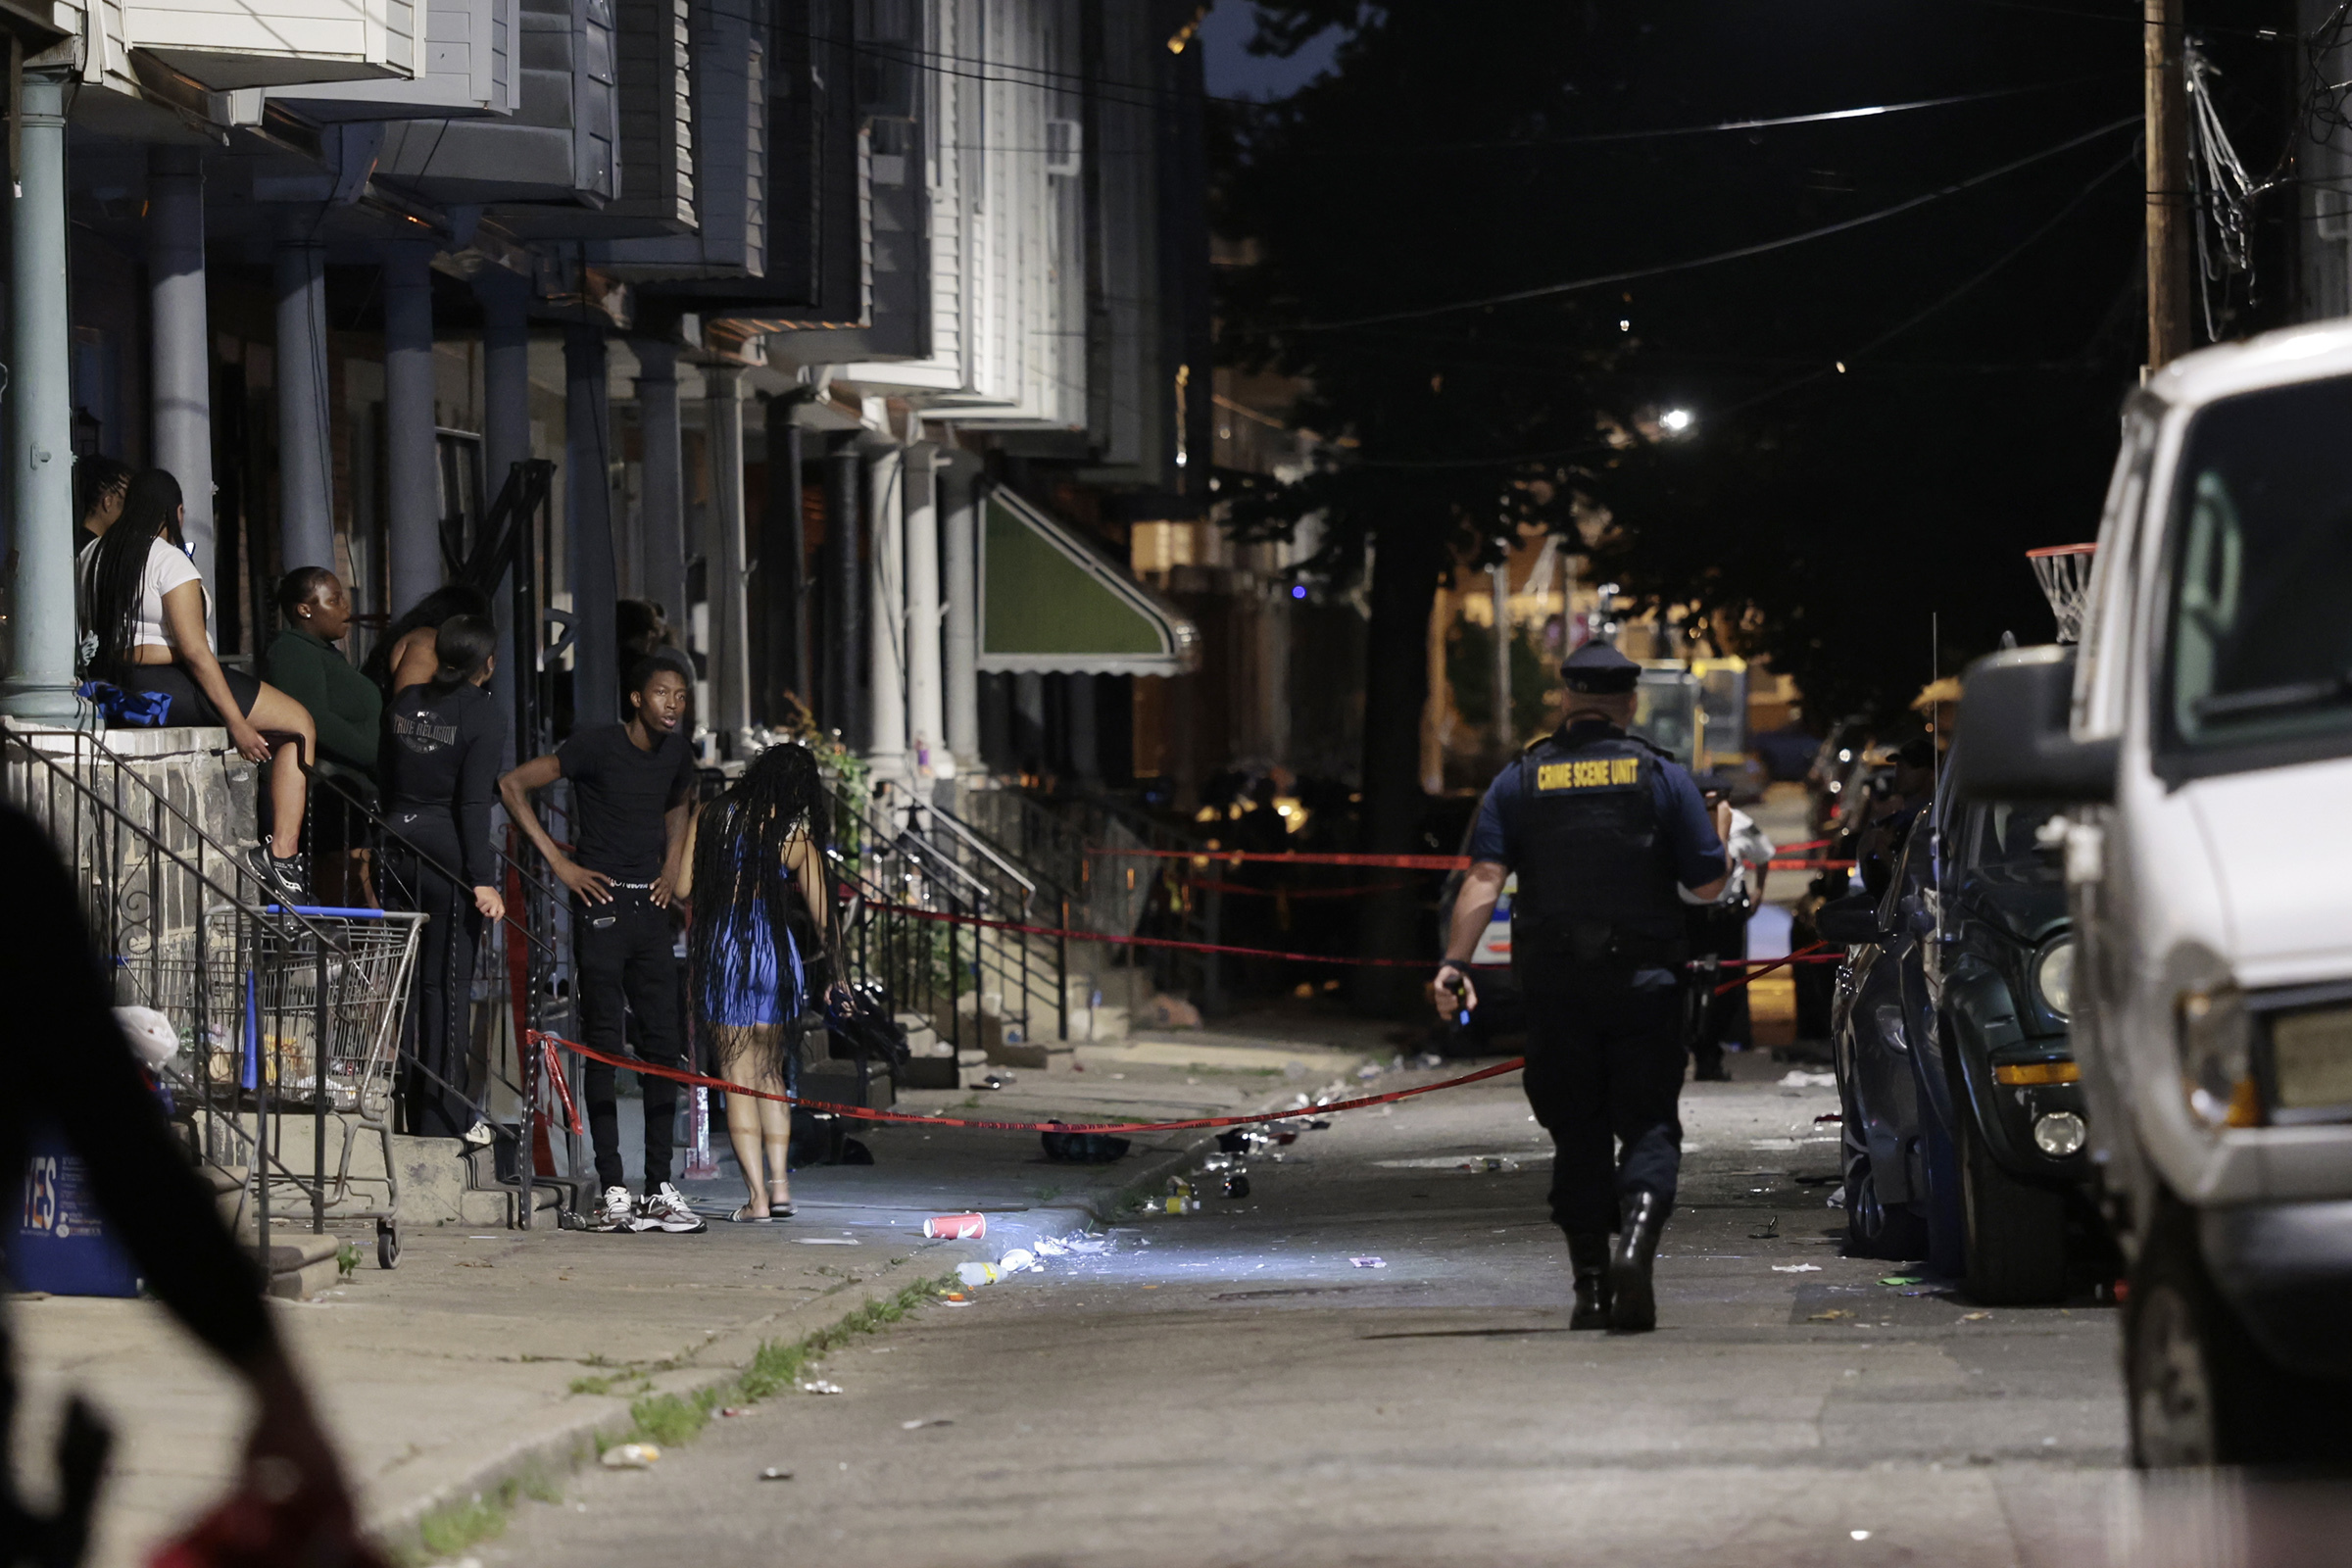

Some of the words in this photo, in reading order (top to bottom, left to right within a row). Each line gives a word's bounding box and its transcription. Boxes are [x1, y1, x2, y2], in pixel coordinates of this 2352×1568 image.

[393, 713, 416, 735] TRUE
[416, 723, 458, 746] RELIGION
[1538, 762, 1572, 791] CRIME
[1573, 759, 1610, 787] SCENE
[1610, 758, 1639, 785] UNIT
[24, 1156, 57, 1230] YES
